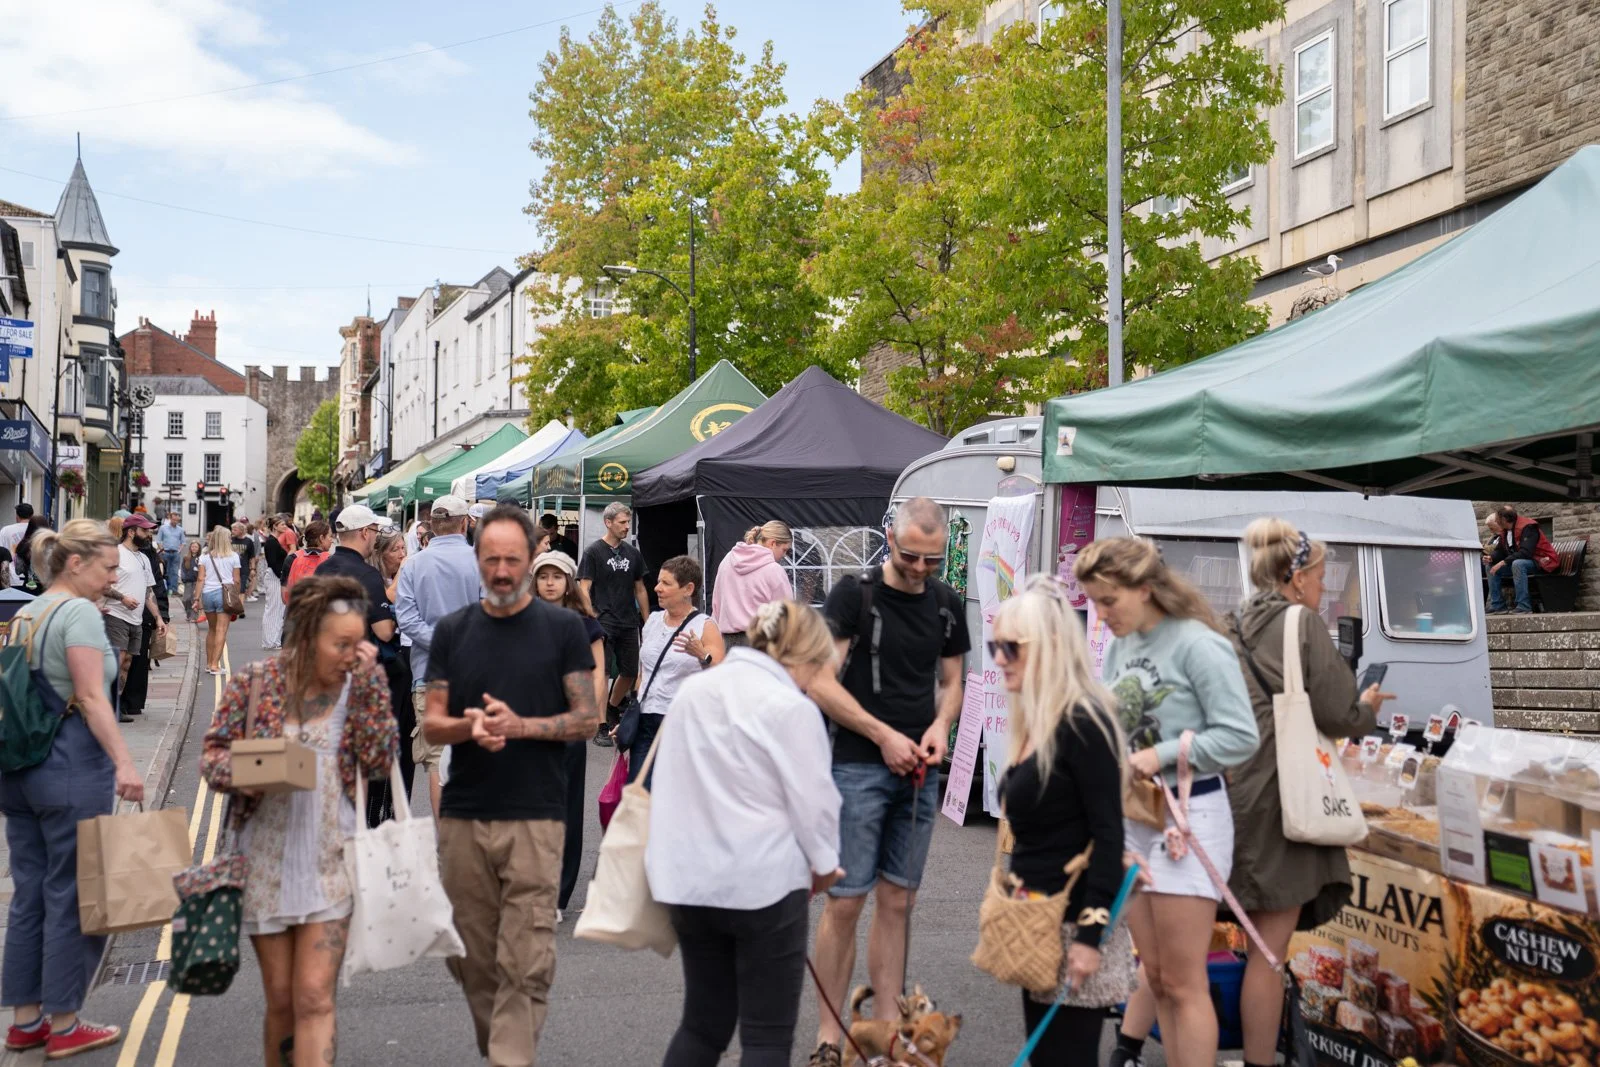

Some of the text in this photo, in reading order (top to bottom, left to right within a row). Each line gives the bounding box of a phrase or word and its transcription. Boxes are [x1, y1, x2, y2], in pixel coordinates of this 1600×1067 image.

[1322, 795, 1352, 817] SAKE
[1350, 872, 1448, 939] LAVA
[1374, 922, 1420, 952] NUTS
[1494, 922, 1581, 960] CASHEW
[1505, 943, 1563, 974] NUTS
[1304, 1029, 1357, 1065] RKISH
